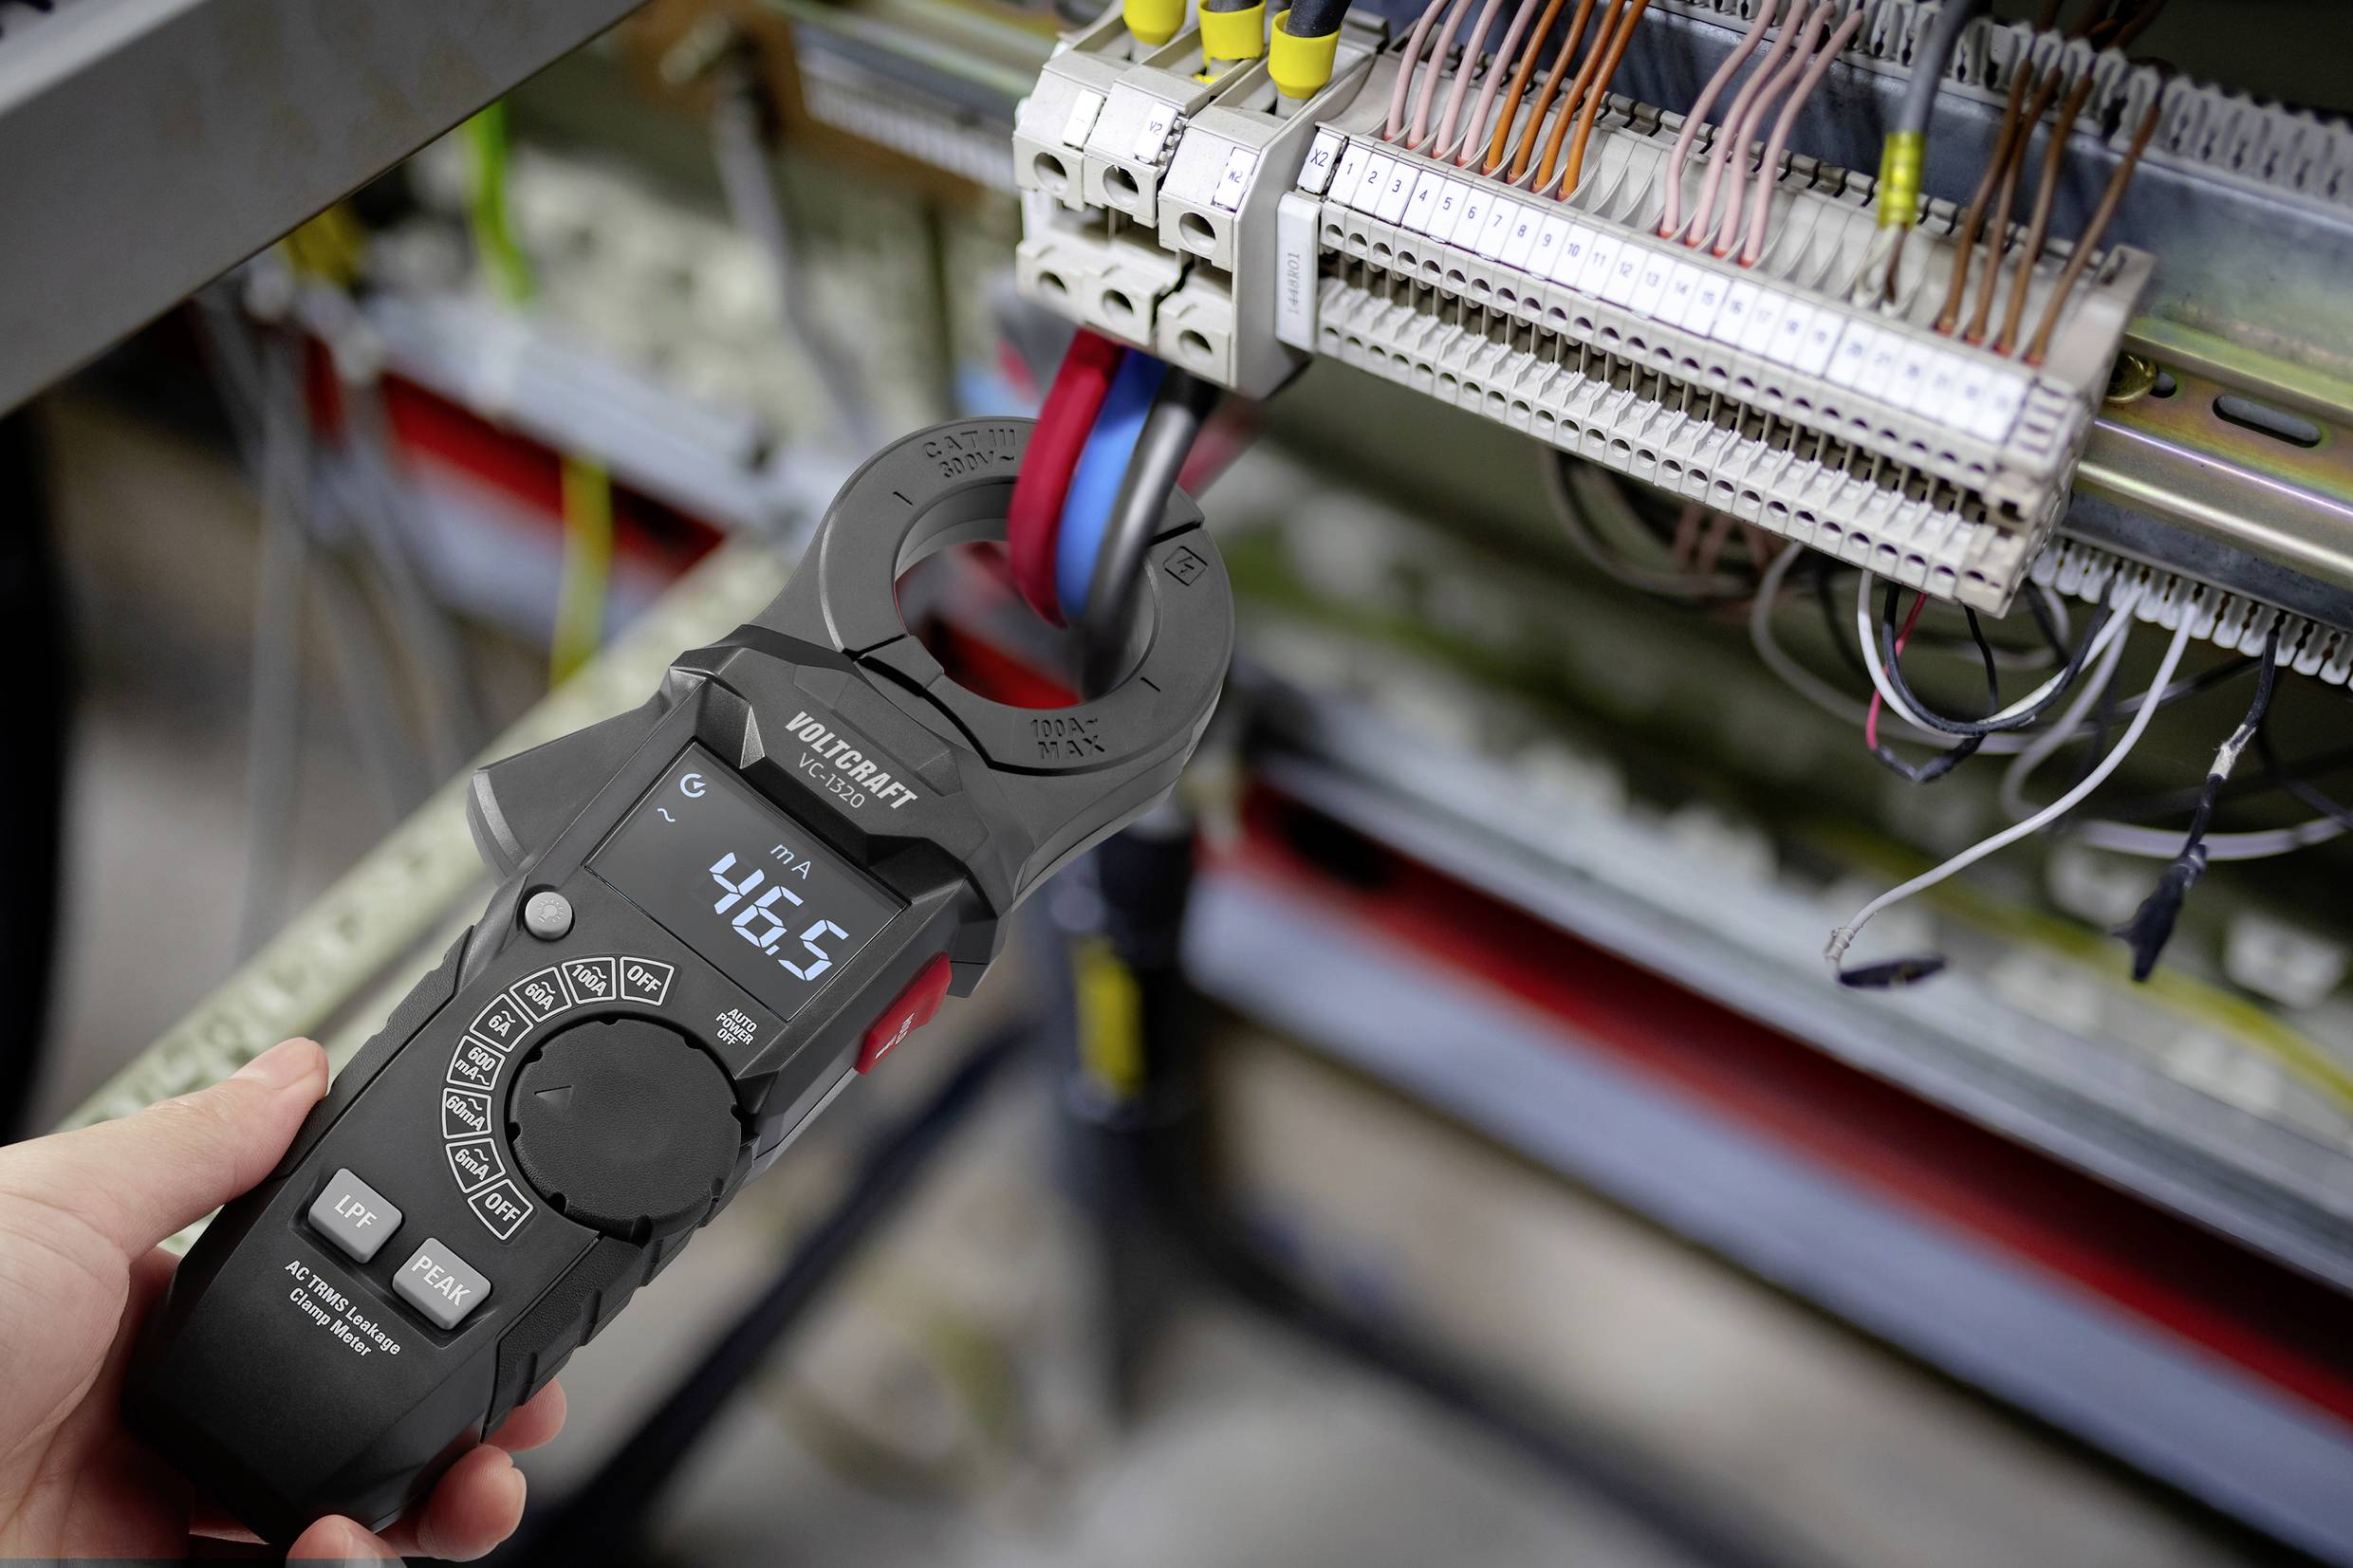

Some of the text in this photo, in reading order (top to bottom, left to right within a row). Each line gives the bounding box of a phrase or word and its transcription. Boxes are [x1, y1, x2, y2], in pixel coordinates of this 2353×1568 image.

[1149, 120, 1162, 136] V2
[1310, 149, 1328, 168] X2
[1347, 163, 1354, 175] 1
[1368, 171, 1378, 184] 2
[1391, 179, 1401, 193] 3
[1419, 189, 1428, 202] 4
[1443, 196, 1454, 211] 5
[1467, 206, 1476, 219] 6
[1493, 214, 1503, 228] 7
[1517, 224, 1528, 238] 8
[1542, 233, 1551, 247] 9
[1567, 242, 1580, 257] 10
[1594, 251, 1606, 267] 11
[1619, 262, 1633, 278] 12
[1646, 272, 1658, 287] 13
[1676, 281, 1688, 295] 14
[1702, 291, 1714, 304] 15
[923, 429, 1015, 457] CAT III
[785, 711, 917, 809] VOLTCRAFT
[1037, 735, 1105, 759] MAX
[799, 752, 865, 809] VC-1320
[709, 853, 849, 981] 46.5
[626, 966, 661, 992] OFF
[716, 1012, 753, 1045] POWER
[716, 1028, 737, 1045] OFF
[728, 1008, 757, 1032] AUTO
[468, 1046, 495, 1071] 600
[335, 1193, 379, 1229] LPF
[485, 1192, 520, 1224] OFF
[412, 1255, 471, 1306] PEAK
[285, 1260, 400, 1356] AC TRMS Leakage
[289, 1287, 372, 1356] Clamp Meter
